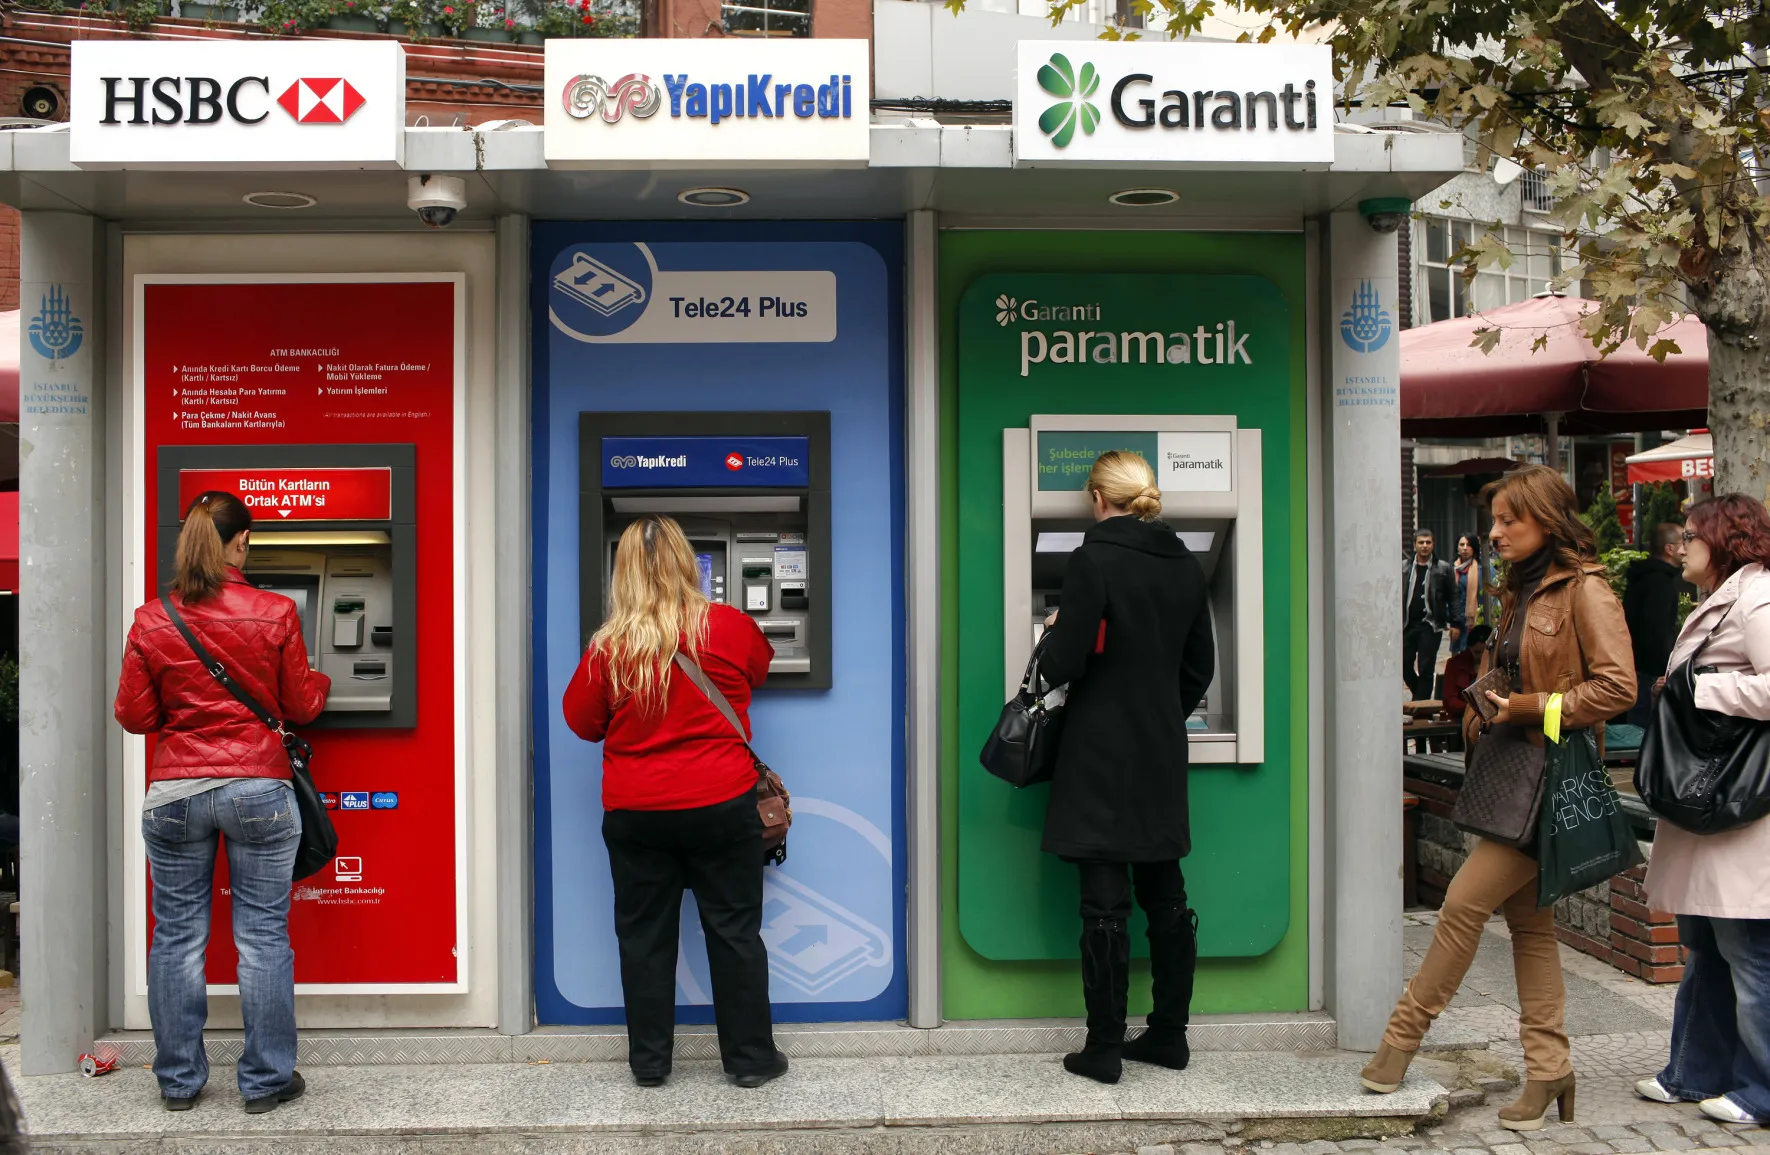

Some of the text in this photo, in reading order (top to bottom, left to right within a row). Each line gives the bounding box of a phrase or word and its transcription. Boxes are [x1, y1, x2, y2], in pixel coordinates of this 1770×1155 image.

[98, 76, 269, 125] HSBC
[663, 74, 851, 124] YapıKredi
[1110, 73, 1317, 129] Garanti
[669, 296, 808, 318] Tele24 Plus
[1020, 300, 1101, 321] Garanti
[270, 346, 340, 357] ATM BANKACILIĞI
[1020, 320, 1252, 377] paramatik
[182, 362, 300, 373] Anında Kredi Kartı Borcu Ödeme
[326, 363, 347, 372] Nakit
[349, 363, 373, 371] Olarak
[375, 363, 398, 371] Fatura
[400, 361, 426, 371] Ödeme
[181, 373, 204, 383] (Kartlı
[210, 373, 238, 383] Kartsız)
[326, 372, 382, 381] Mobil Yükleme
[182, 387, 286, 396] Anında Hesaba Para Yatırma
[327, 385, 388, 396] Yatırım İşlemleri
[181, 397, 204, 406] (Kartlı
[210, 396, 239, 406] Kartsız)
[182, 411, 199, 420] Para
[200, 411, 226, 421] Çekme
[231, 410, 252, 419] Nakit
[253, 410, 277, 419] Avans
[181, 419, 286, 430] (Tüm Bankaların Kartlarıyla)
[1049, 446, 1095, 461] Şubede
[636, 455, 687, 469] YapıKredi
[746, 456, 799, 467] Tele24 Plus
[1172, 458, 1224, 471] paramatik
[1038, 462, 1059, 474] her
[239, 478, 330, 491] Bütün Kartların
[244, 495, 278, 507] Ortak
[344, 886, 385, 896] Bankacılığı
